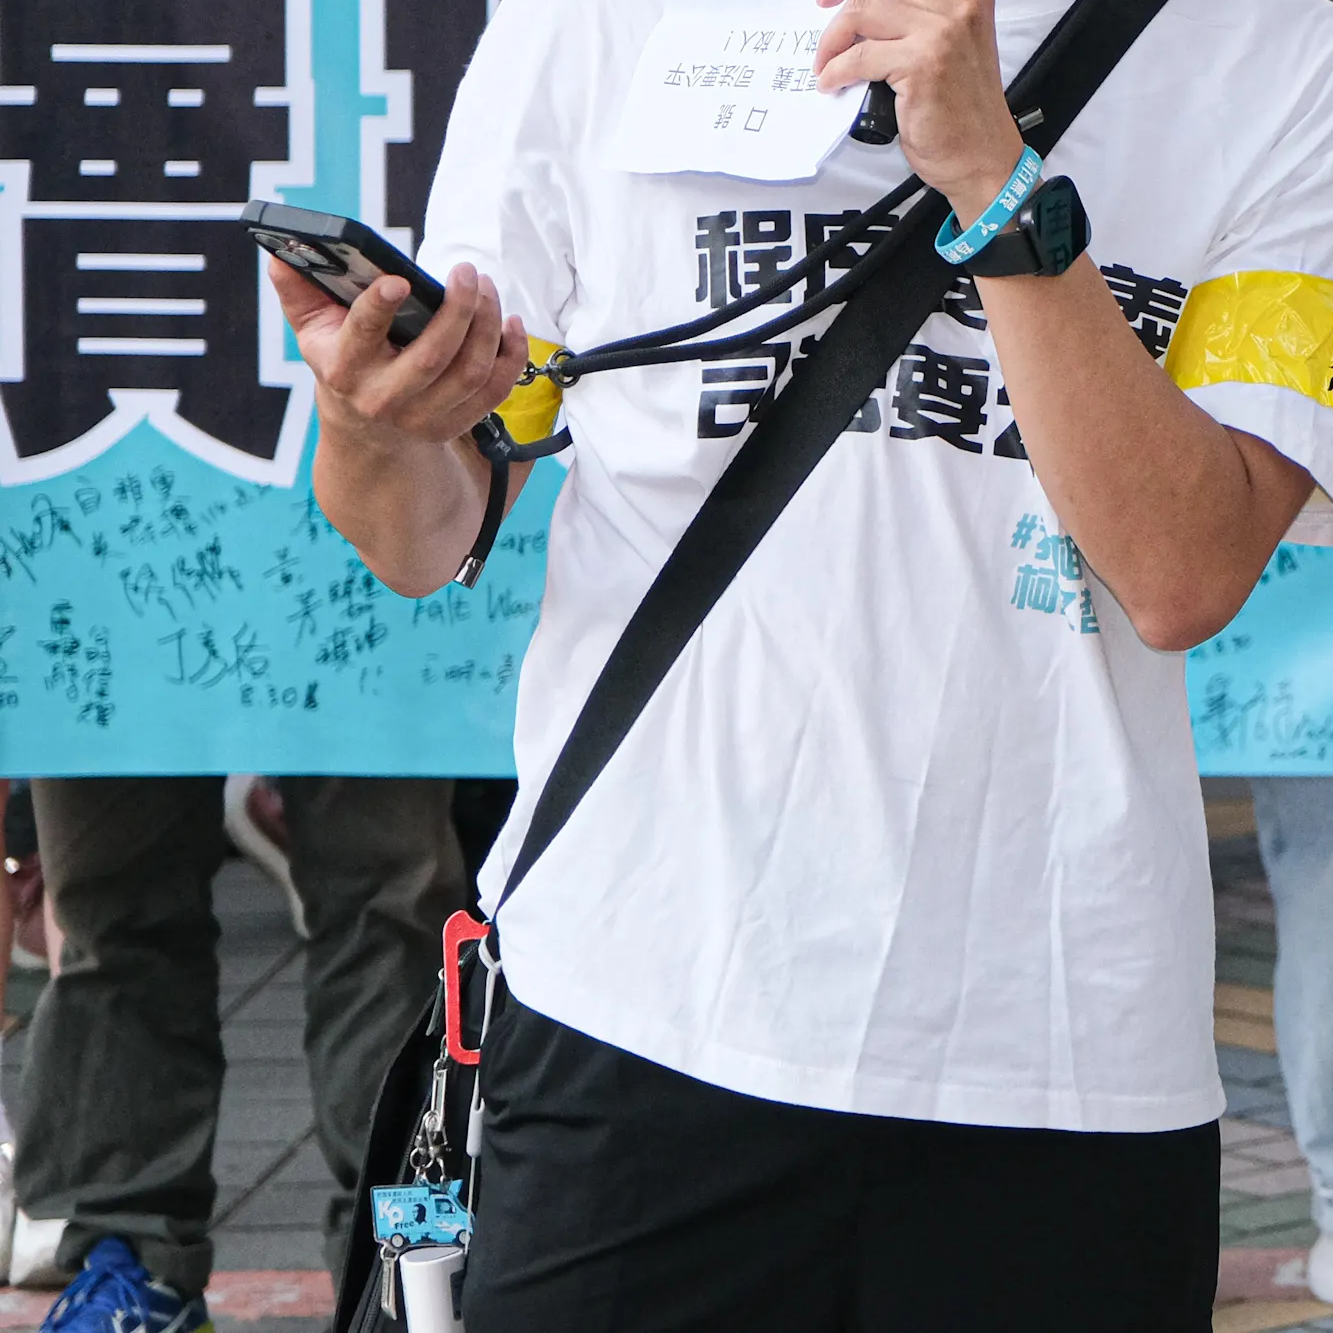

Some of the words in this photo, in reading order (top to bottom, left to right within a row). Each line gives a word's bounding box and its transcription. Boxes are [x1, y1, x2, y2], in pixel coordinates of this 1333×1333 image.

[663, 62, 755, 89] 司法要公平
[697, 343, 1031, 461] 司要
